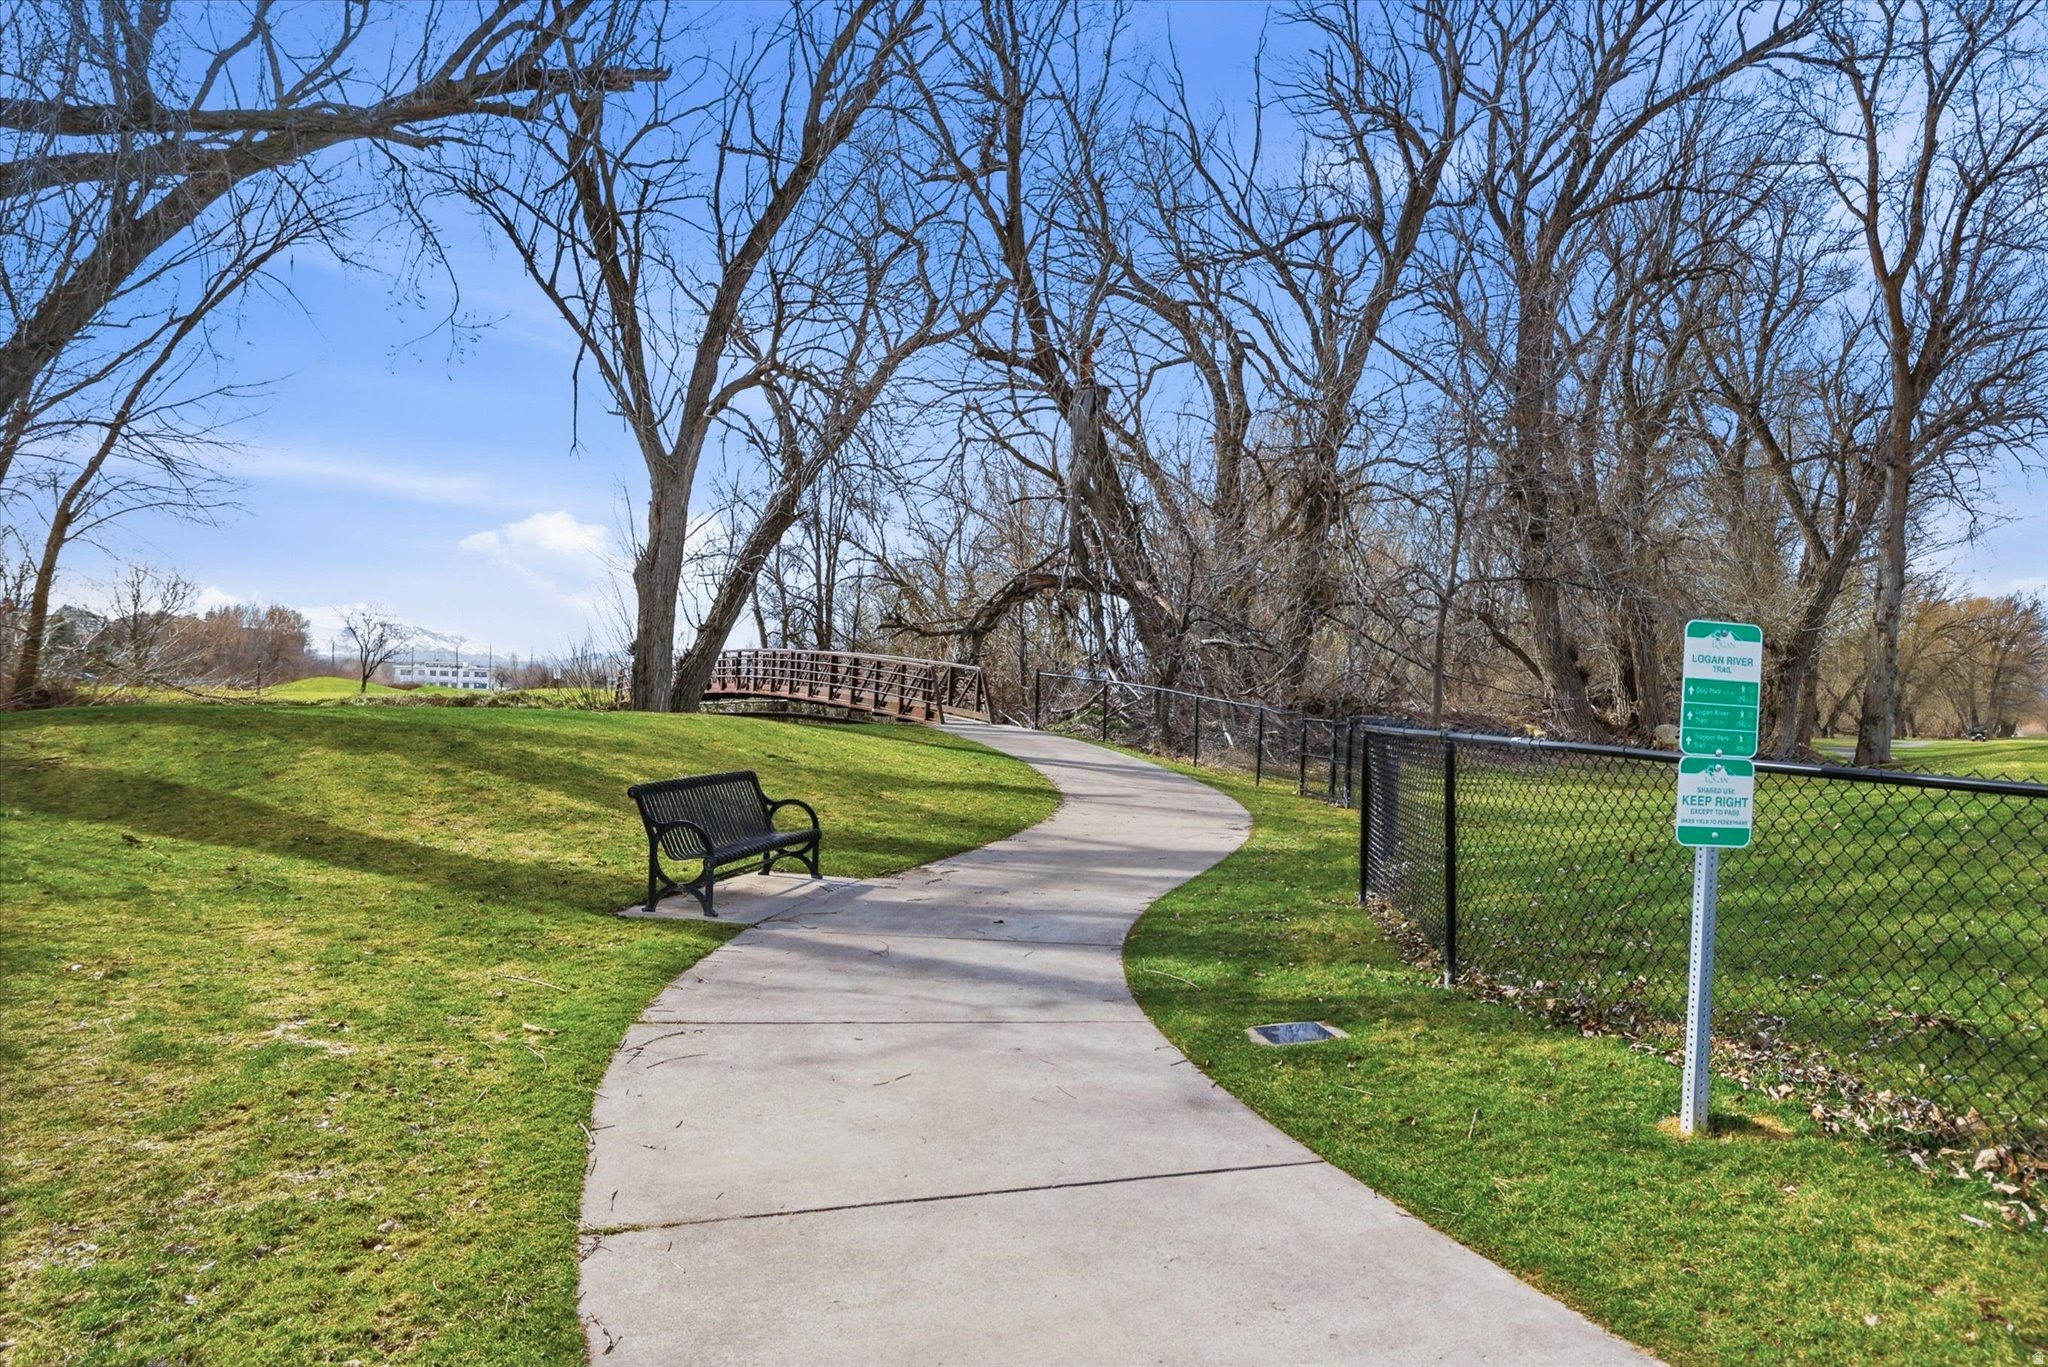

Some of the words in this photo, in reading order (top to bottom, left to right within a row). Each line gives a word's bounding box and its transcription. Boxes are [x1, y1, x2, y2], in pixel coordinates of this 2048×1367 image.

[1692, 654, 1724, 665] LOGAN
[1726, 656, 1754, 667] RIVER
[1712, 665, 1732, 674] TRAIL
[1697, 786, 1722, 794] SHARED
[1682, 795, 1712, 806] KEEP
[1715, 796, 1749, 808] RIGHT
[1715, 808, 1723, 816] TO
